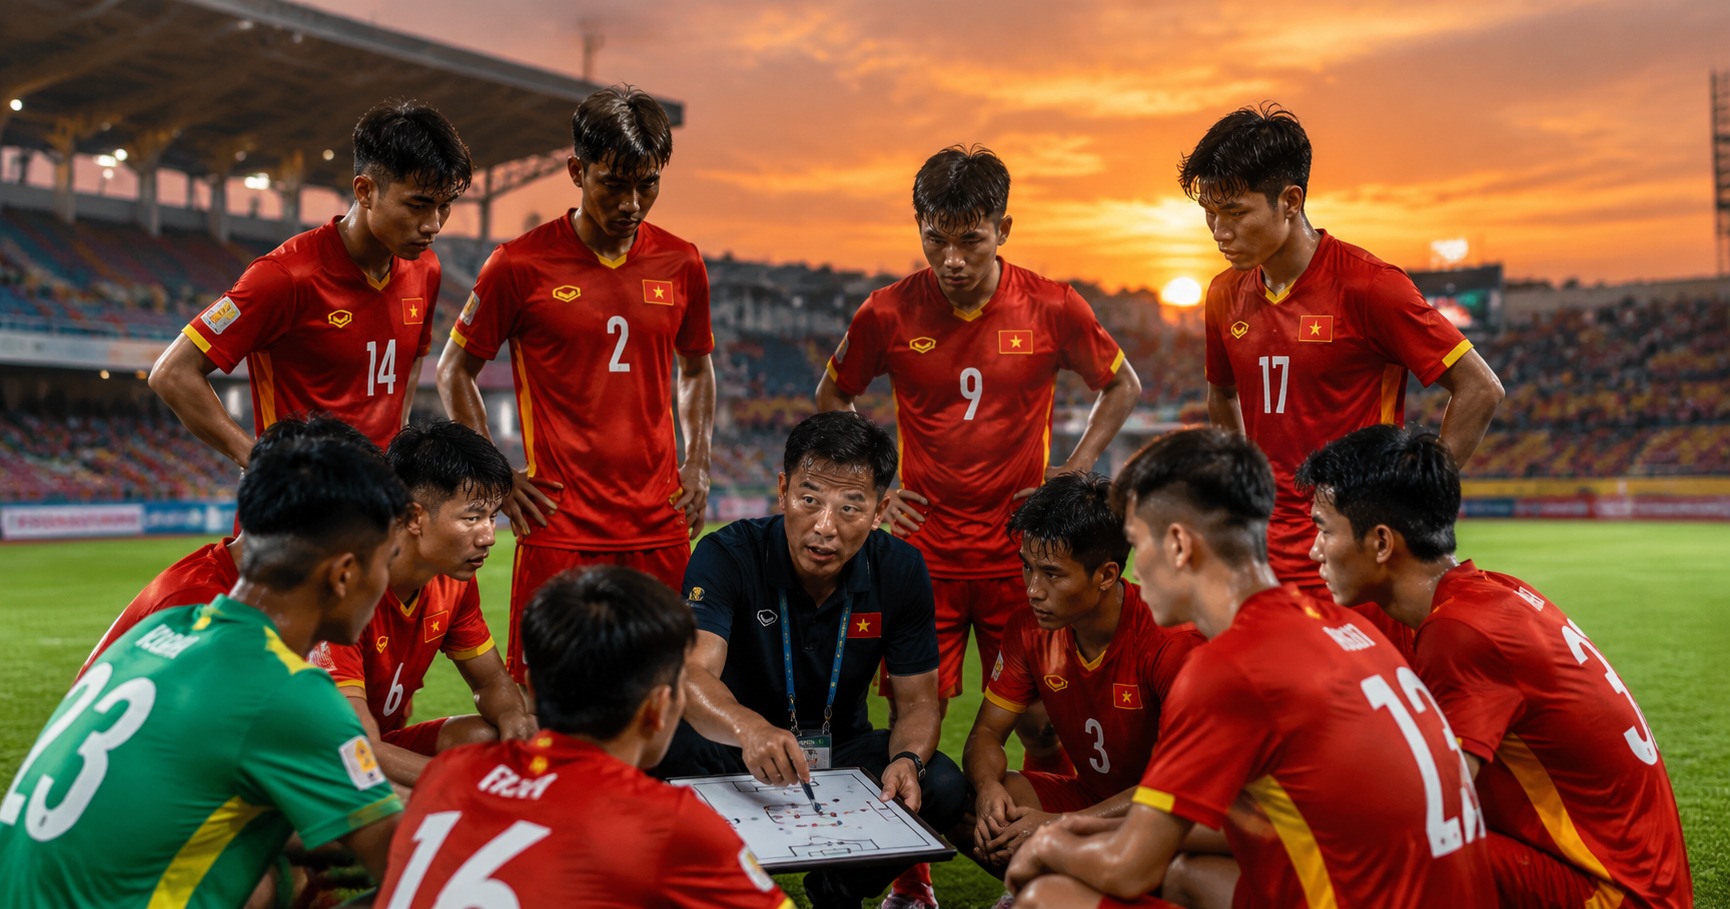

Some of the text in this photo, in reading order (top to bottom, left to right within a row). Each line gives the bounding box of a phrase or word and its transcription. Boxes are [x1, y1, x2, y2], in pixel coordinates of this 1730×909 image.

[366, 339, 396, 397] 14
[608, 315, 631, 373] 2
[959, 367, 983, 421] 9
[1258, 355, 1290, 414] 17
[383, 662, 404, 717] 6
[0, 661, 156, 842] 23
[1084, 717, 1111, 775] 3
[386, 811, 552, 909] 16
